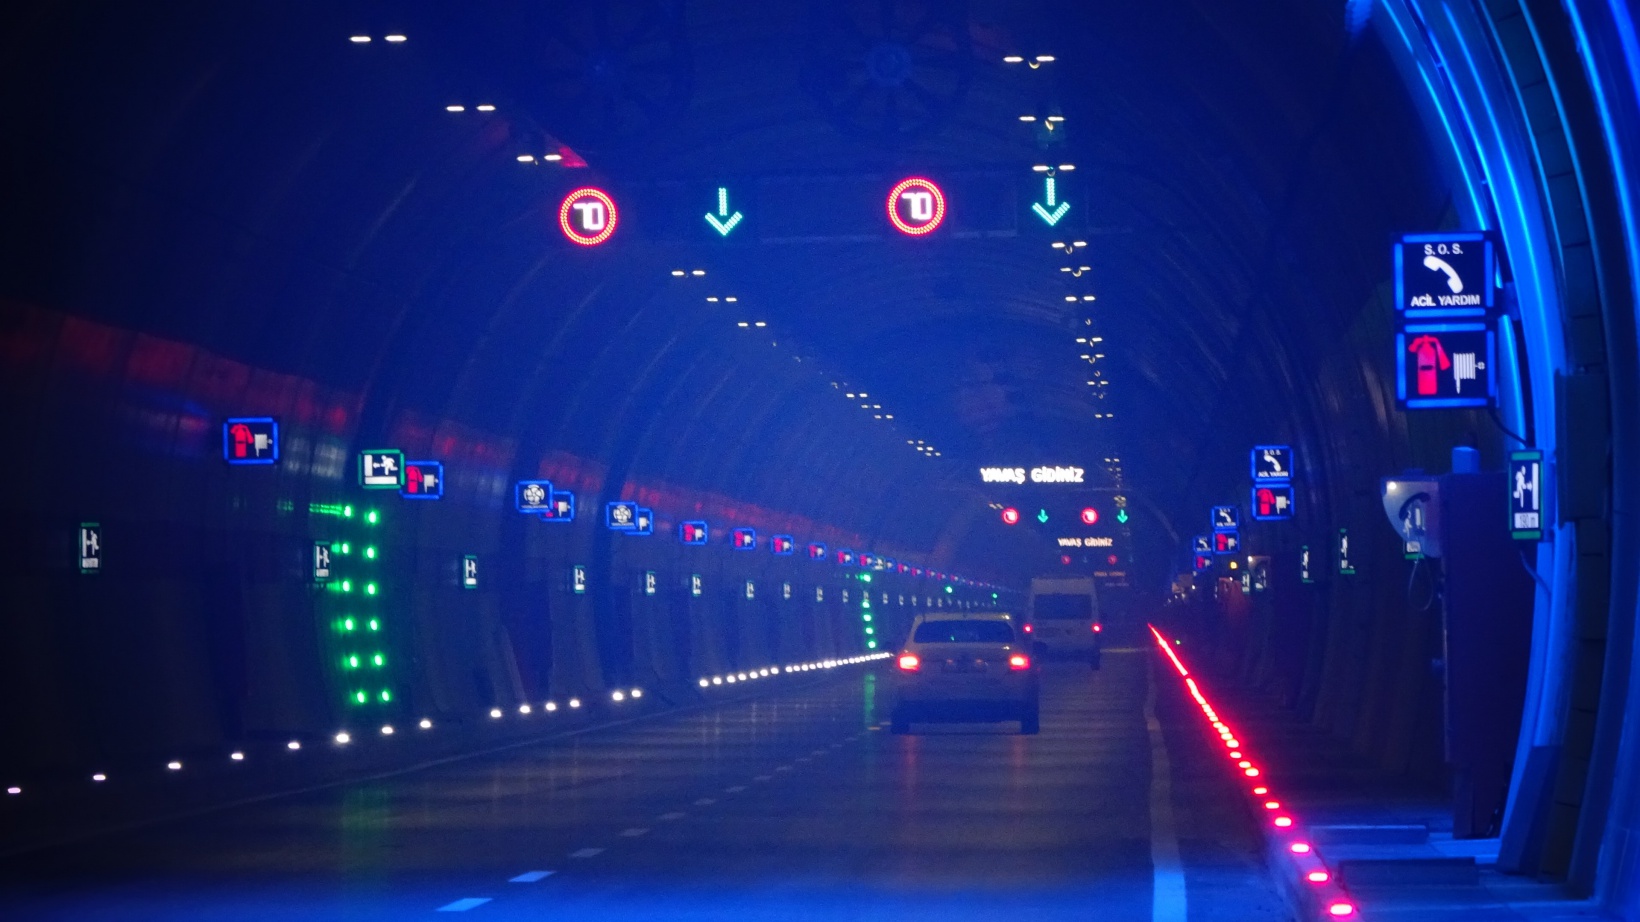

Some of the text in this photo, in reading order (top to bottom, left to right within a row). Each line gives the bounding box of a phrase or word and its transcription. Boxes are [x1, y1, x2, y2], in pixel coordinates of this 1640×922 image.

[574, 202, 604, 231] 70
[902, 192, 932, 220] 70
[1410, 293, 1480, 307] ACİL YARDIM
[980, 466, 1084, 484] YAVAŞ GİDİNİZ
